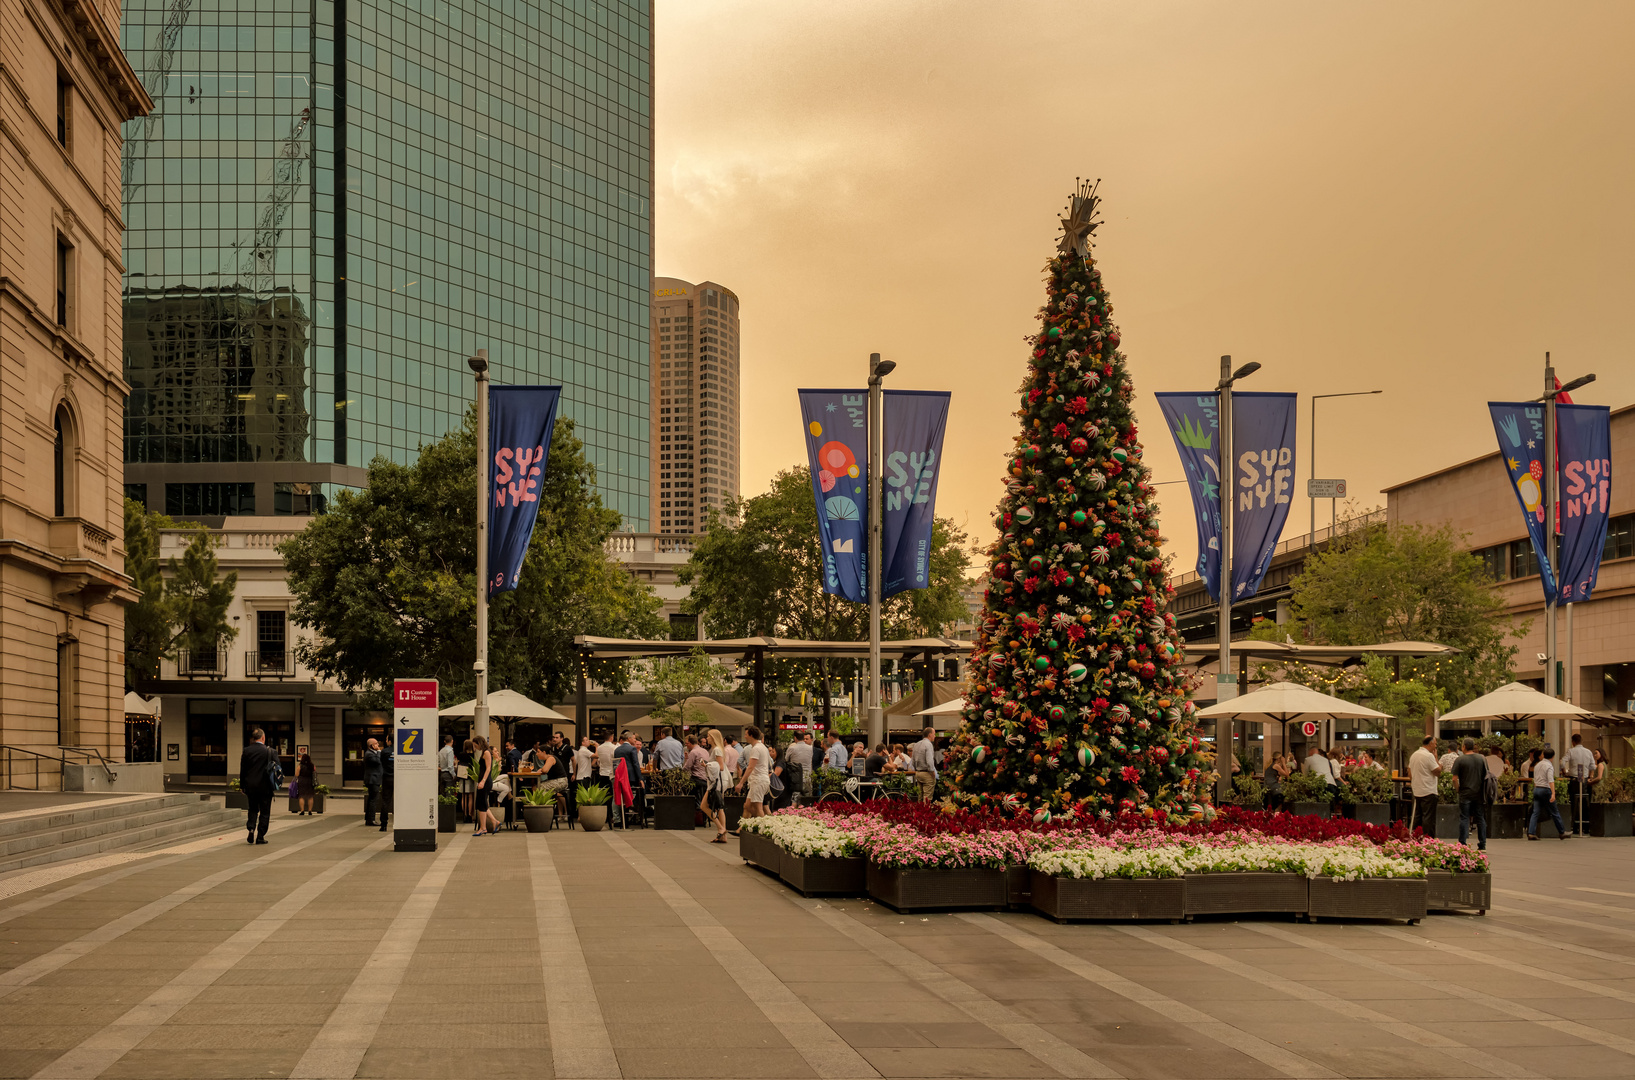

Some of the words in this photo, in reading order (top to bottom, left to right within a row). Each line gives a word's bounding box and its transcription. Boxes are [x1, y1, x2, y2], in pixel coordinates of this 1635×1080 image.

[842, 394, 864, 428] NYE
[1197, 396, 1219, 428] NYE
[1525, 407, 1543, 440] NYE
[495, 445, 544, 485] SYD
[887, 448, 935, 488] SYD
[1239, 447, 1292, 488] SYD
[1564, 458, 1610, 495] SYD
[496, 467, 541, 508] NYE
[1239, 468, 1292, 511] NYE
